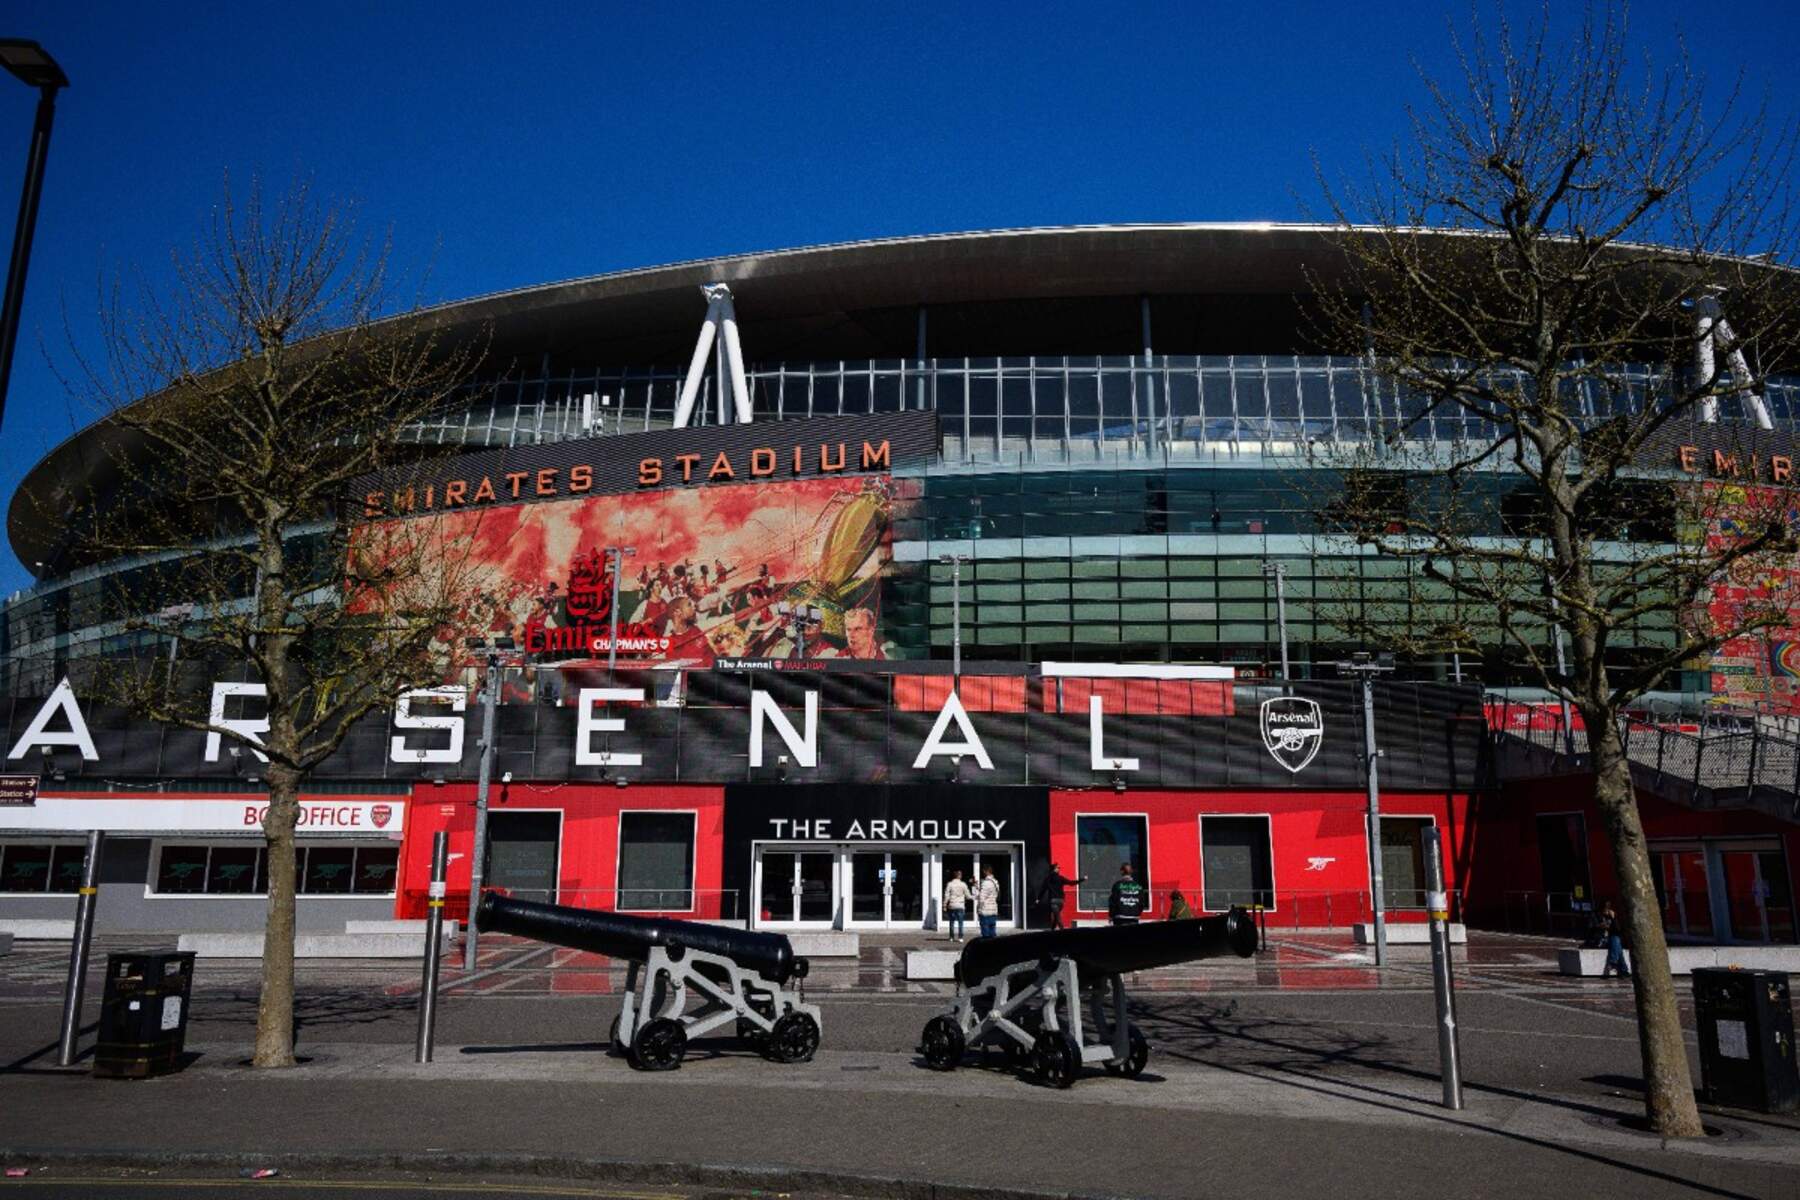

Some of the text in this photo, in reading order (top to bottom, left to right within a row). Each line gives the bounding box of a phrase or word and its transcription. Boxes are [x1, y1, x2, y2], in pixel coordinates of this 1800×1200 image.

[639, 439, 890, 485] STADIUM
[6, 674, 1140, 770] ARSENAL
[1268, 712, 1316, 723] Arsenal
[294, 806, 362, 826] OFFICE
[769, 819, 1007, 840] THE ARMOURY
